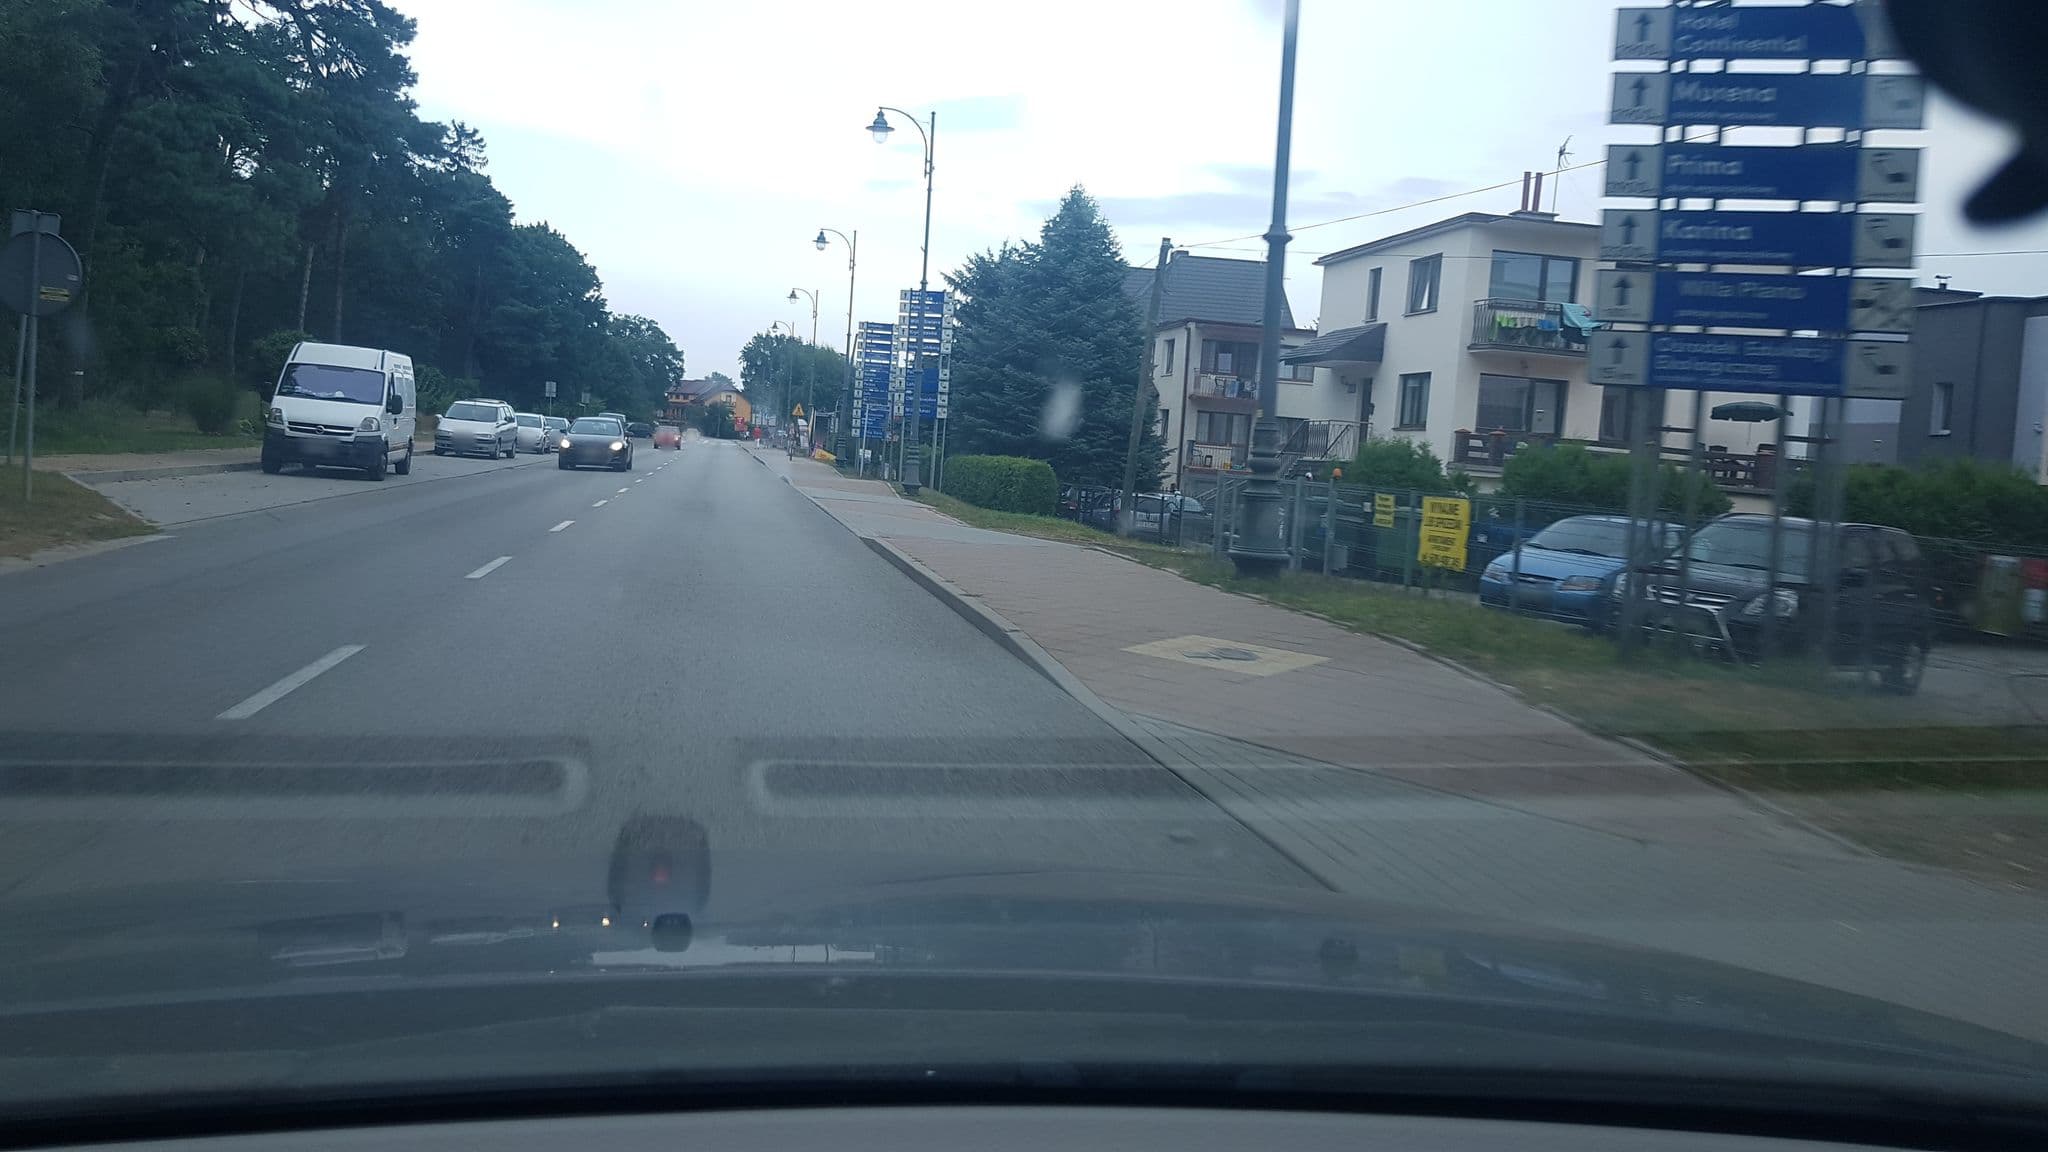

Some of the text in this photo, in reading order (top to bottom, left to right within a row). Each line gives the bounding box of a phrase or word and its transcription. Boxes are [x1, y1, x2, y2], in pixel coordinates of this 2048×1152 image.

[1677, 12, 1739, 30] Hotel
[1675, 34, 1808, 52] Continental
[1673, 81, 1777, 102] Murena
[1665, 154, 1744, 175] Prima
[1662, 219, 1753, 240] Karina
